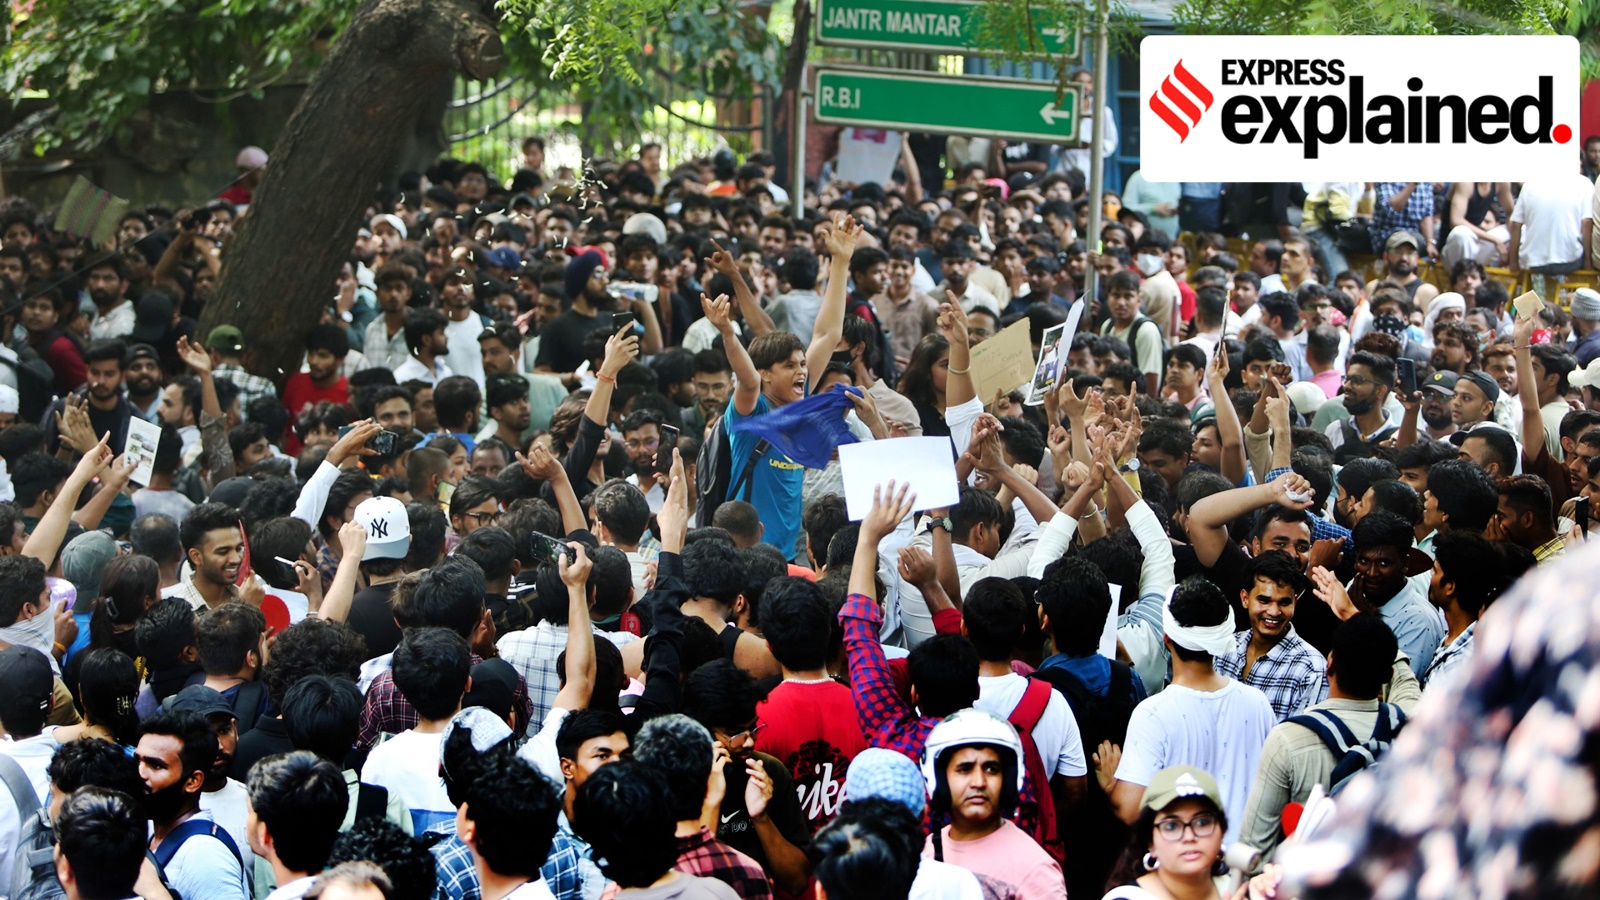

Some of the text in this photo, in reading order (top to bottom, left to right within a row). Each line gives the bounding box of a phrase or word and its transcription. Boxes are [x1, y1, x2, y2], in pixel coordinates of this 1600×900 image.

[824, 7, 961, 38] JANTR MANTAR
[821, 86, 861, 110] R.B.I
